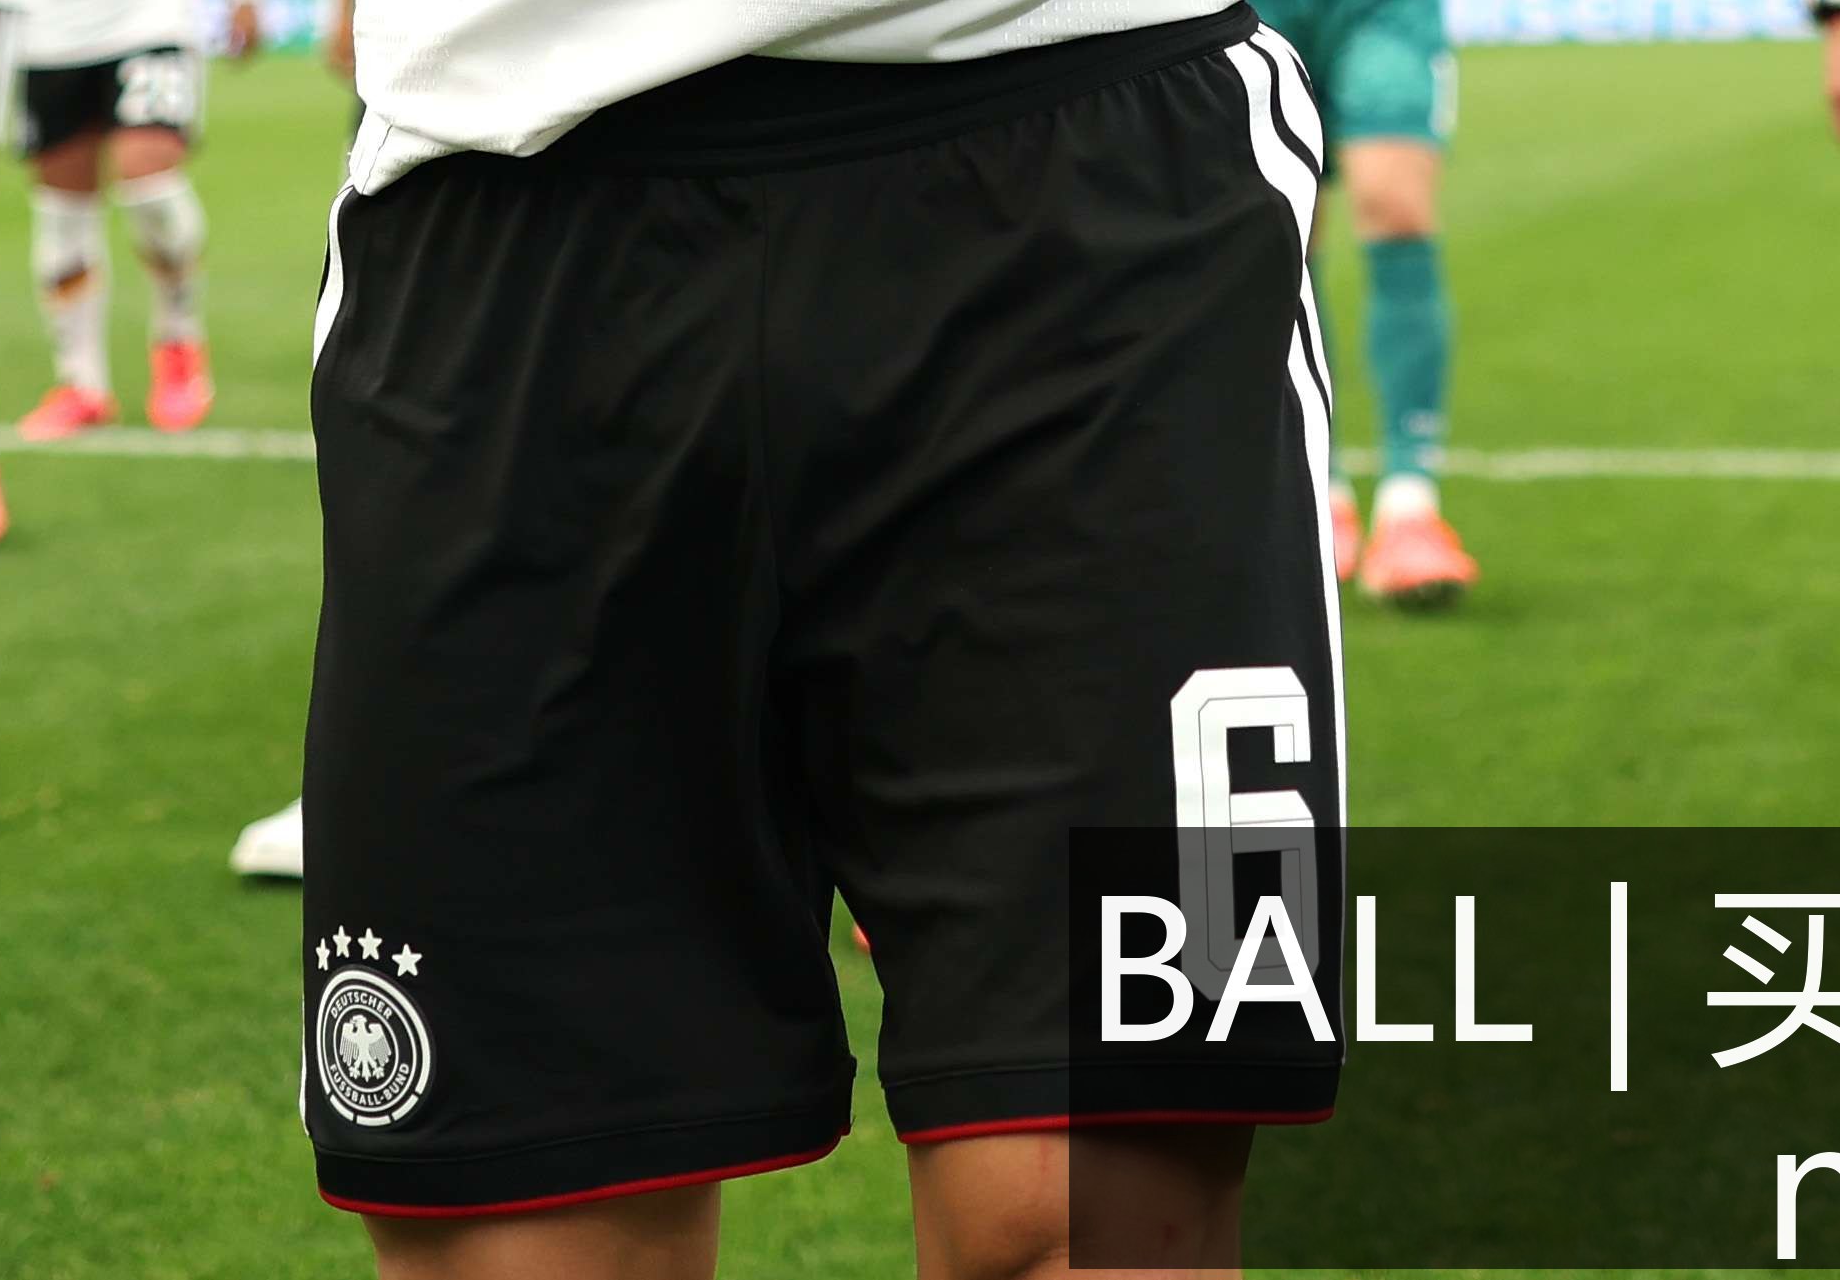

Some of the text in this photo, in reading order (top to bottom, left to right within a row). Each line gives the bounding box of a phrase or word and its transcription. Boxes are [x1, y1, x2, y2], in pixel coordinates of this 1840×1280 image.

[1171, 666, 1319, 1001] 6
[330, 991, 393, 1019] DEUTSCHER
[329, 1063, 410, 1106] FUSSBALL-BUND
